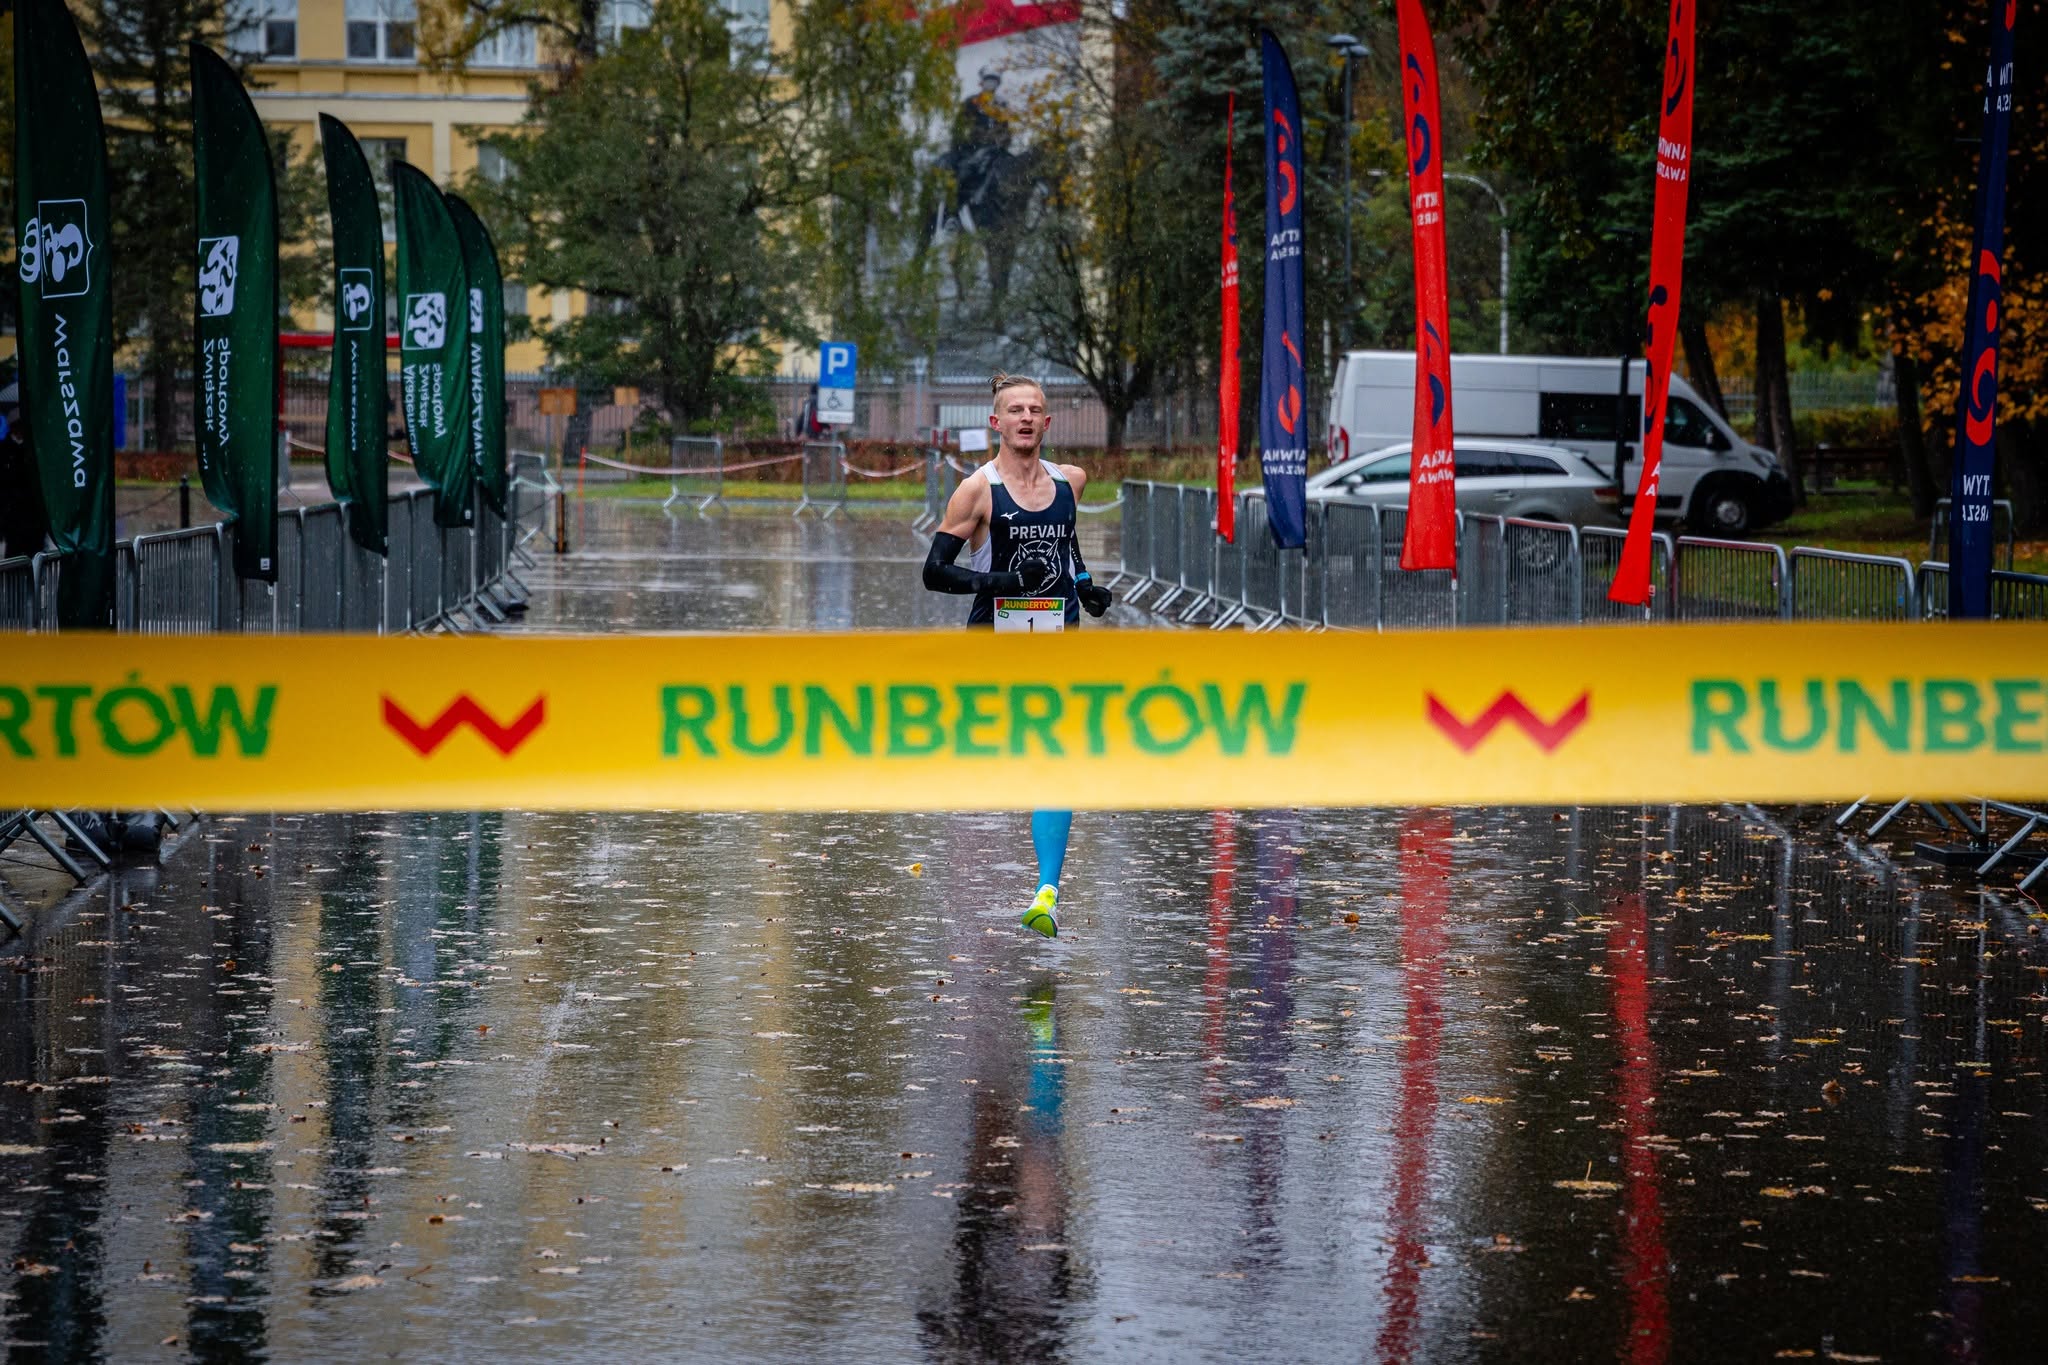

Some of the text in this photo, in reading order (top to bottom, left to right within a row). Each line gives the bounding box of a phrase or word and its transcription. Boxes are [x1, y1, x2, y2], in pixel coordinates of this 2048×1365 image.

[827, 347, 849, 375] P
[1009, 524, 1067, 540] PREVAIL
[659, 668, 1309, 758] RUNBERTÓW
[1688, 677, 2048, 754] RUNBE
